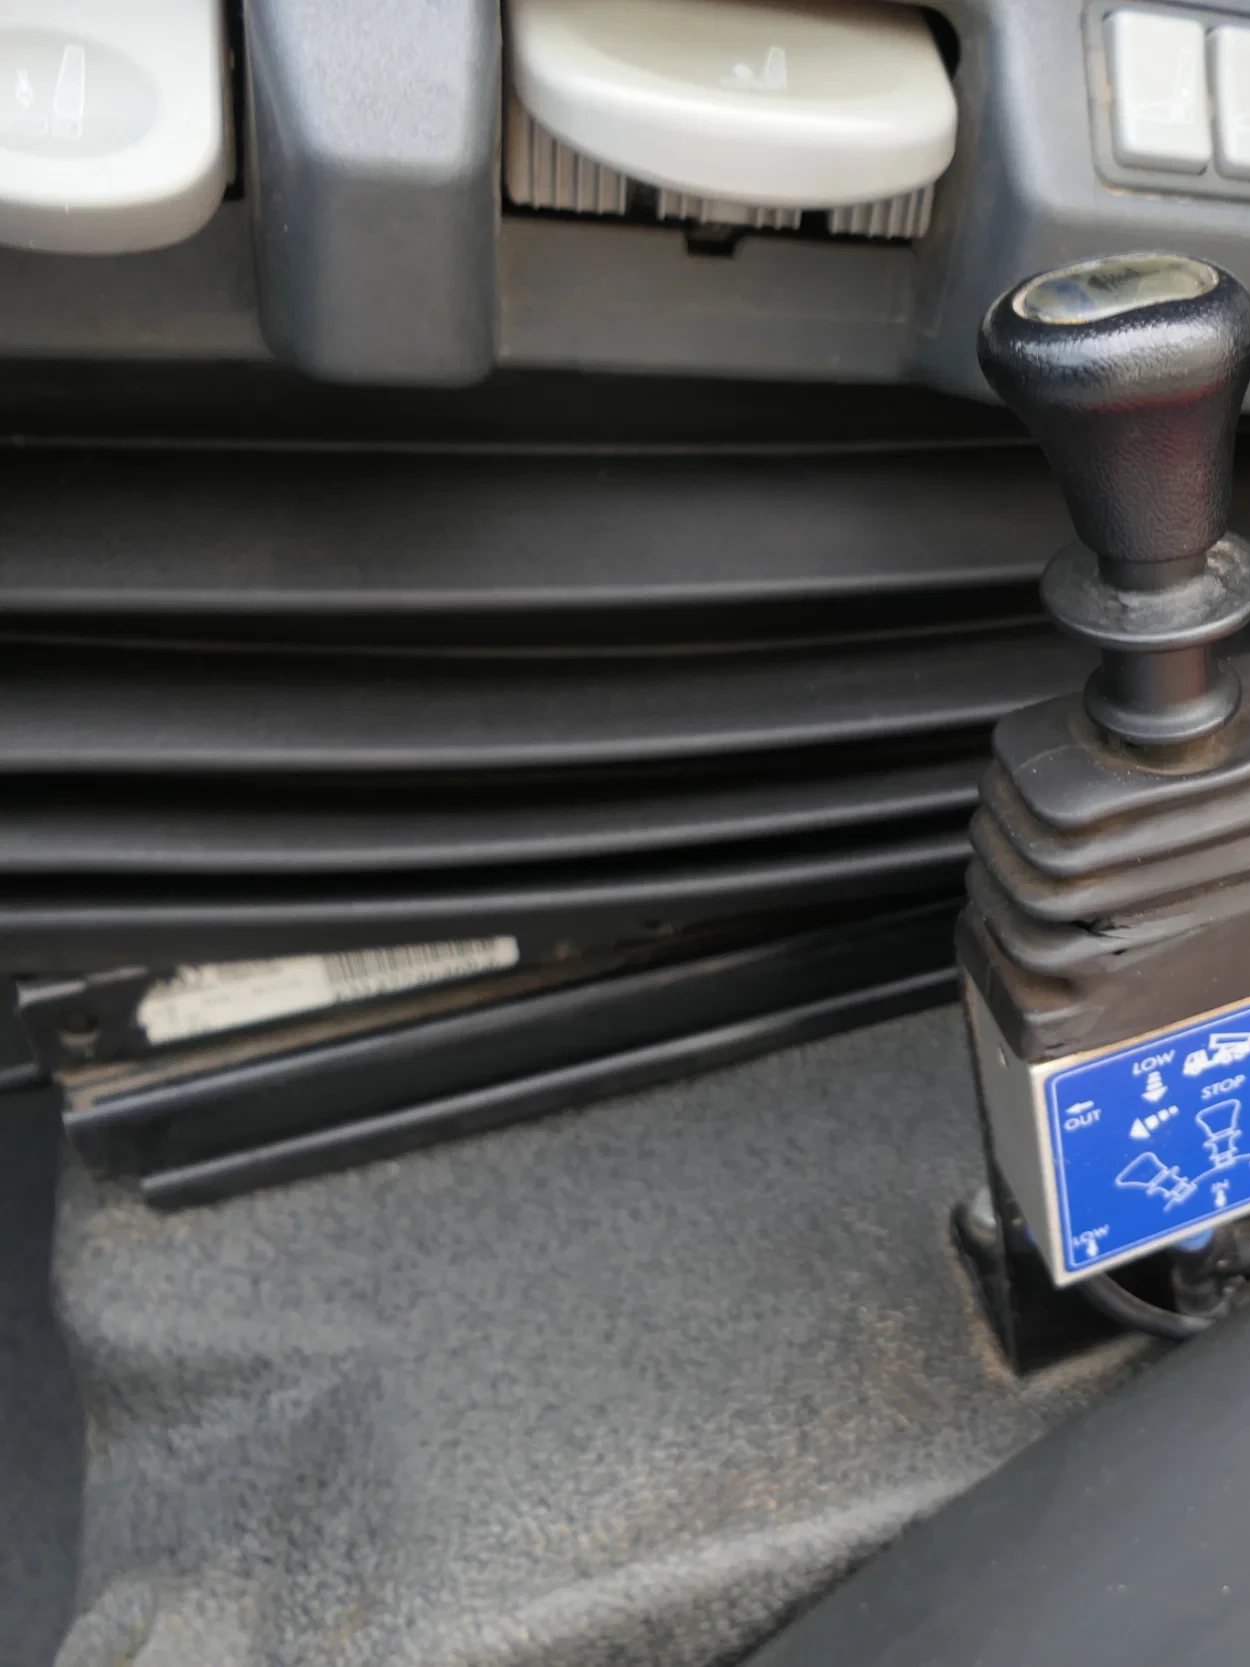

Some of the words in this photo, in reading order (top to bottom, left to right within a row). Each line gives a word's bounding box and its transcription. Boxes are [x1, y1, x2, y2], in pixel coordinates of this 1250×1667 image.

[1131, 1049, 1176, 1077] LOW
[1201, 1074, 1247, 1100] STOP
[1063, 1108, 1102, 1132] OUT
[1072, 1223, 1111, 1247] LOW
